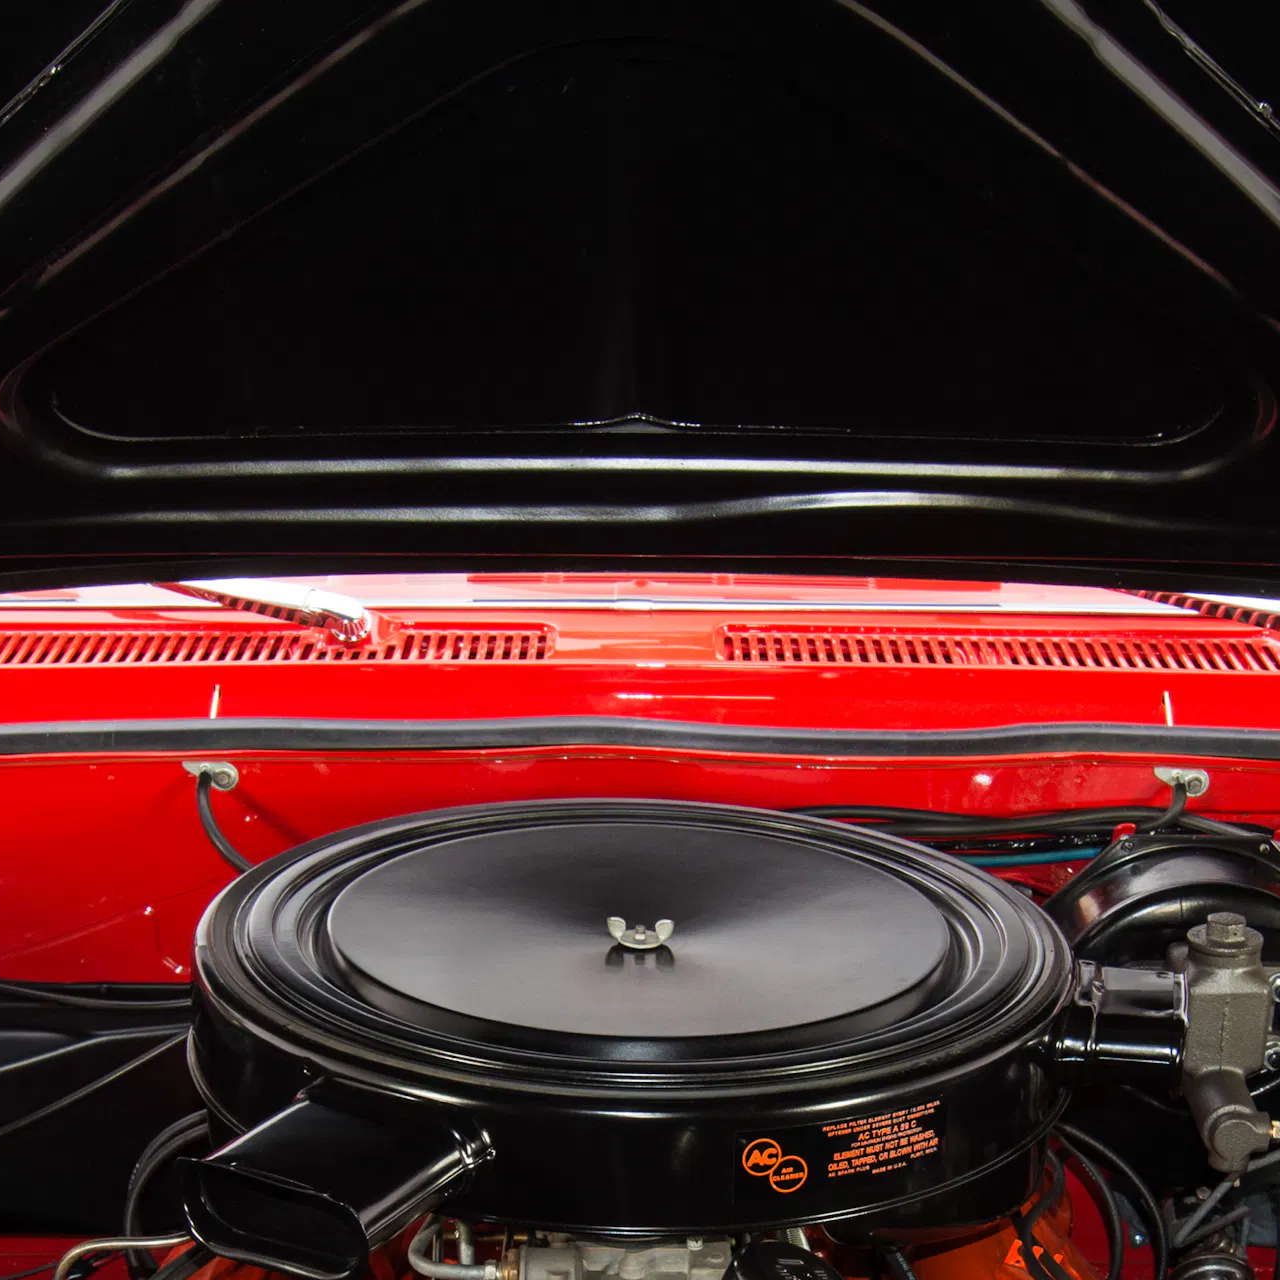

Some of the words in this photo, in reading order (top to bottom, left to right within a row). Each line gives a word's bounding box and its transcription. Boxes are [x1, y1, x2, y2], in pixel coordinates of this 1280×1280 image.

[858, 1131, 870, 1141] AC
[872, 1126, 891, 1137] TYPE
[892, 1125, 899, 1133] A
[911, 1120, 917, 1128] C
[747, 1147, 778, 1167] AC
[833, 1147, 865, 1160] ELEMENT
[866, 1143, 884, 1154] MUST
[885, 1140, 899, 1150] NOT
[900, 1137, 909, 1146] BE
[878, 1151, 889, 1161] OR
[889, 1145, 912, 1159] BLOWN
[913, 1140, 929, 1152] WITH
[929, 1137, 939, 1147] AIR
[772, 1172, 804, 1182] CLEANER
[837, 1168, 855, 1176] SPARK
[872, 1166, 886, 1174] MADE
